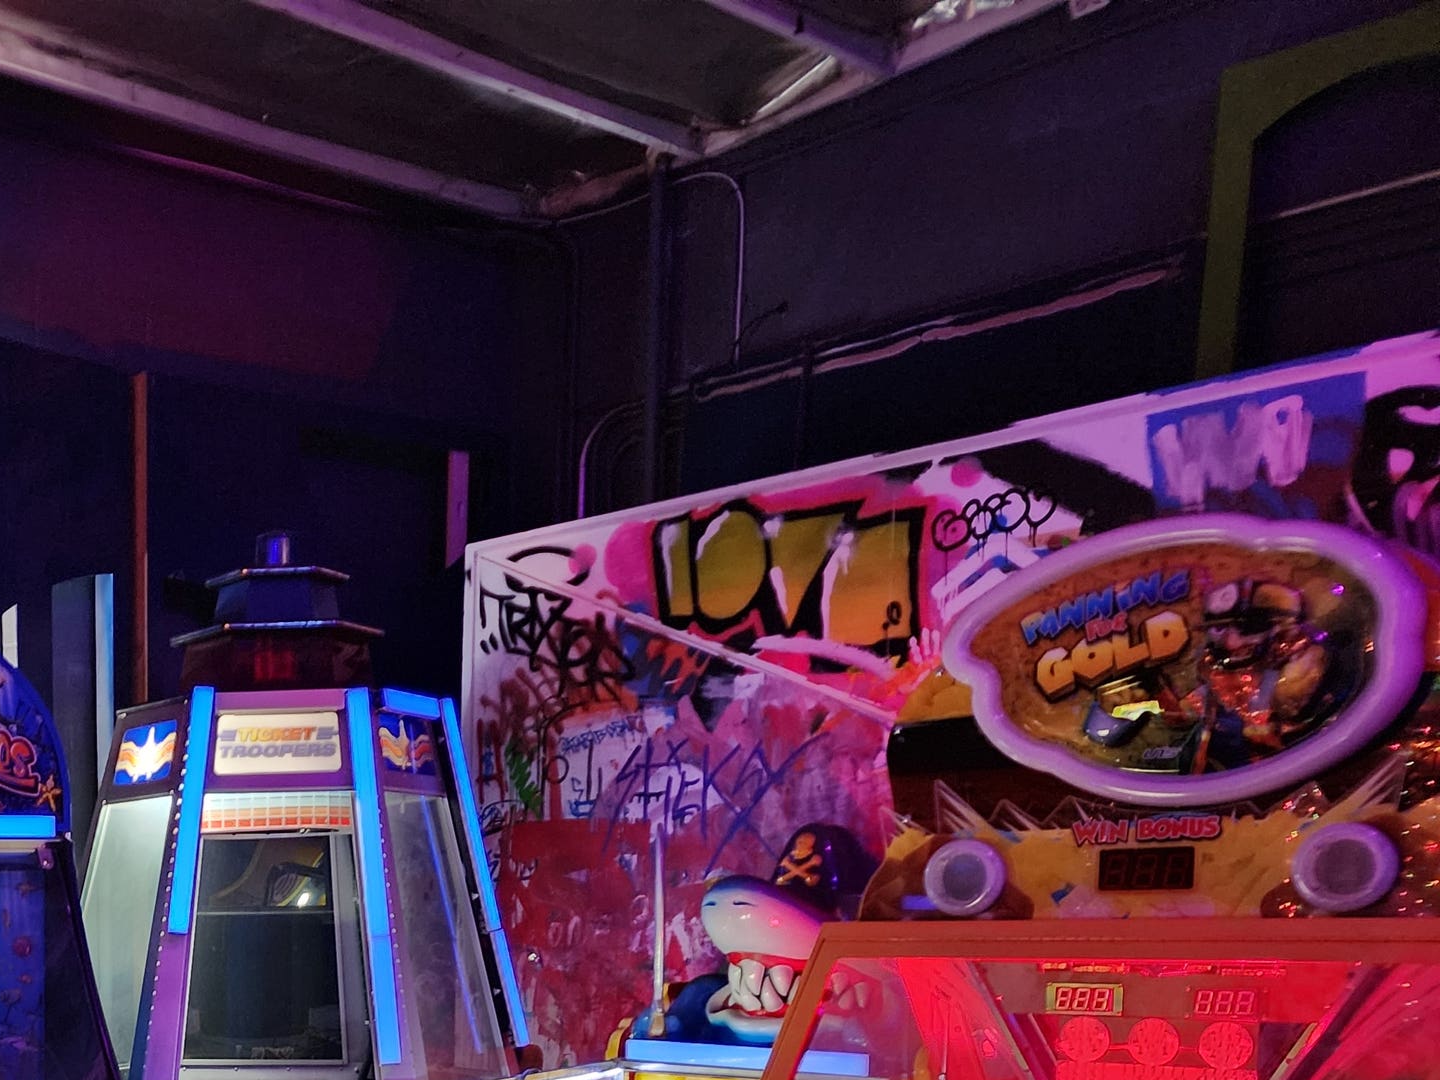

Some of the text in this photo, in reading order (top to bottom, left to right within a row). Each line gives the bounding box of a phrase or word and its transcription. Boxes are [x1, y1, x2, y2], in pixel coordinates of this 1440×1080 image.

[1021, 570, 1192, 645] PANNING
[1085, 611, 1129, 642] FOR
[1035, 611, 1191, 702] GOLD
[220, 741, 338, 758] TROOPERS
[238, 726, 318, 742] TICKET
[1072, 814, 1222, 847] WIN BONUS
